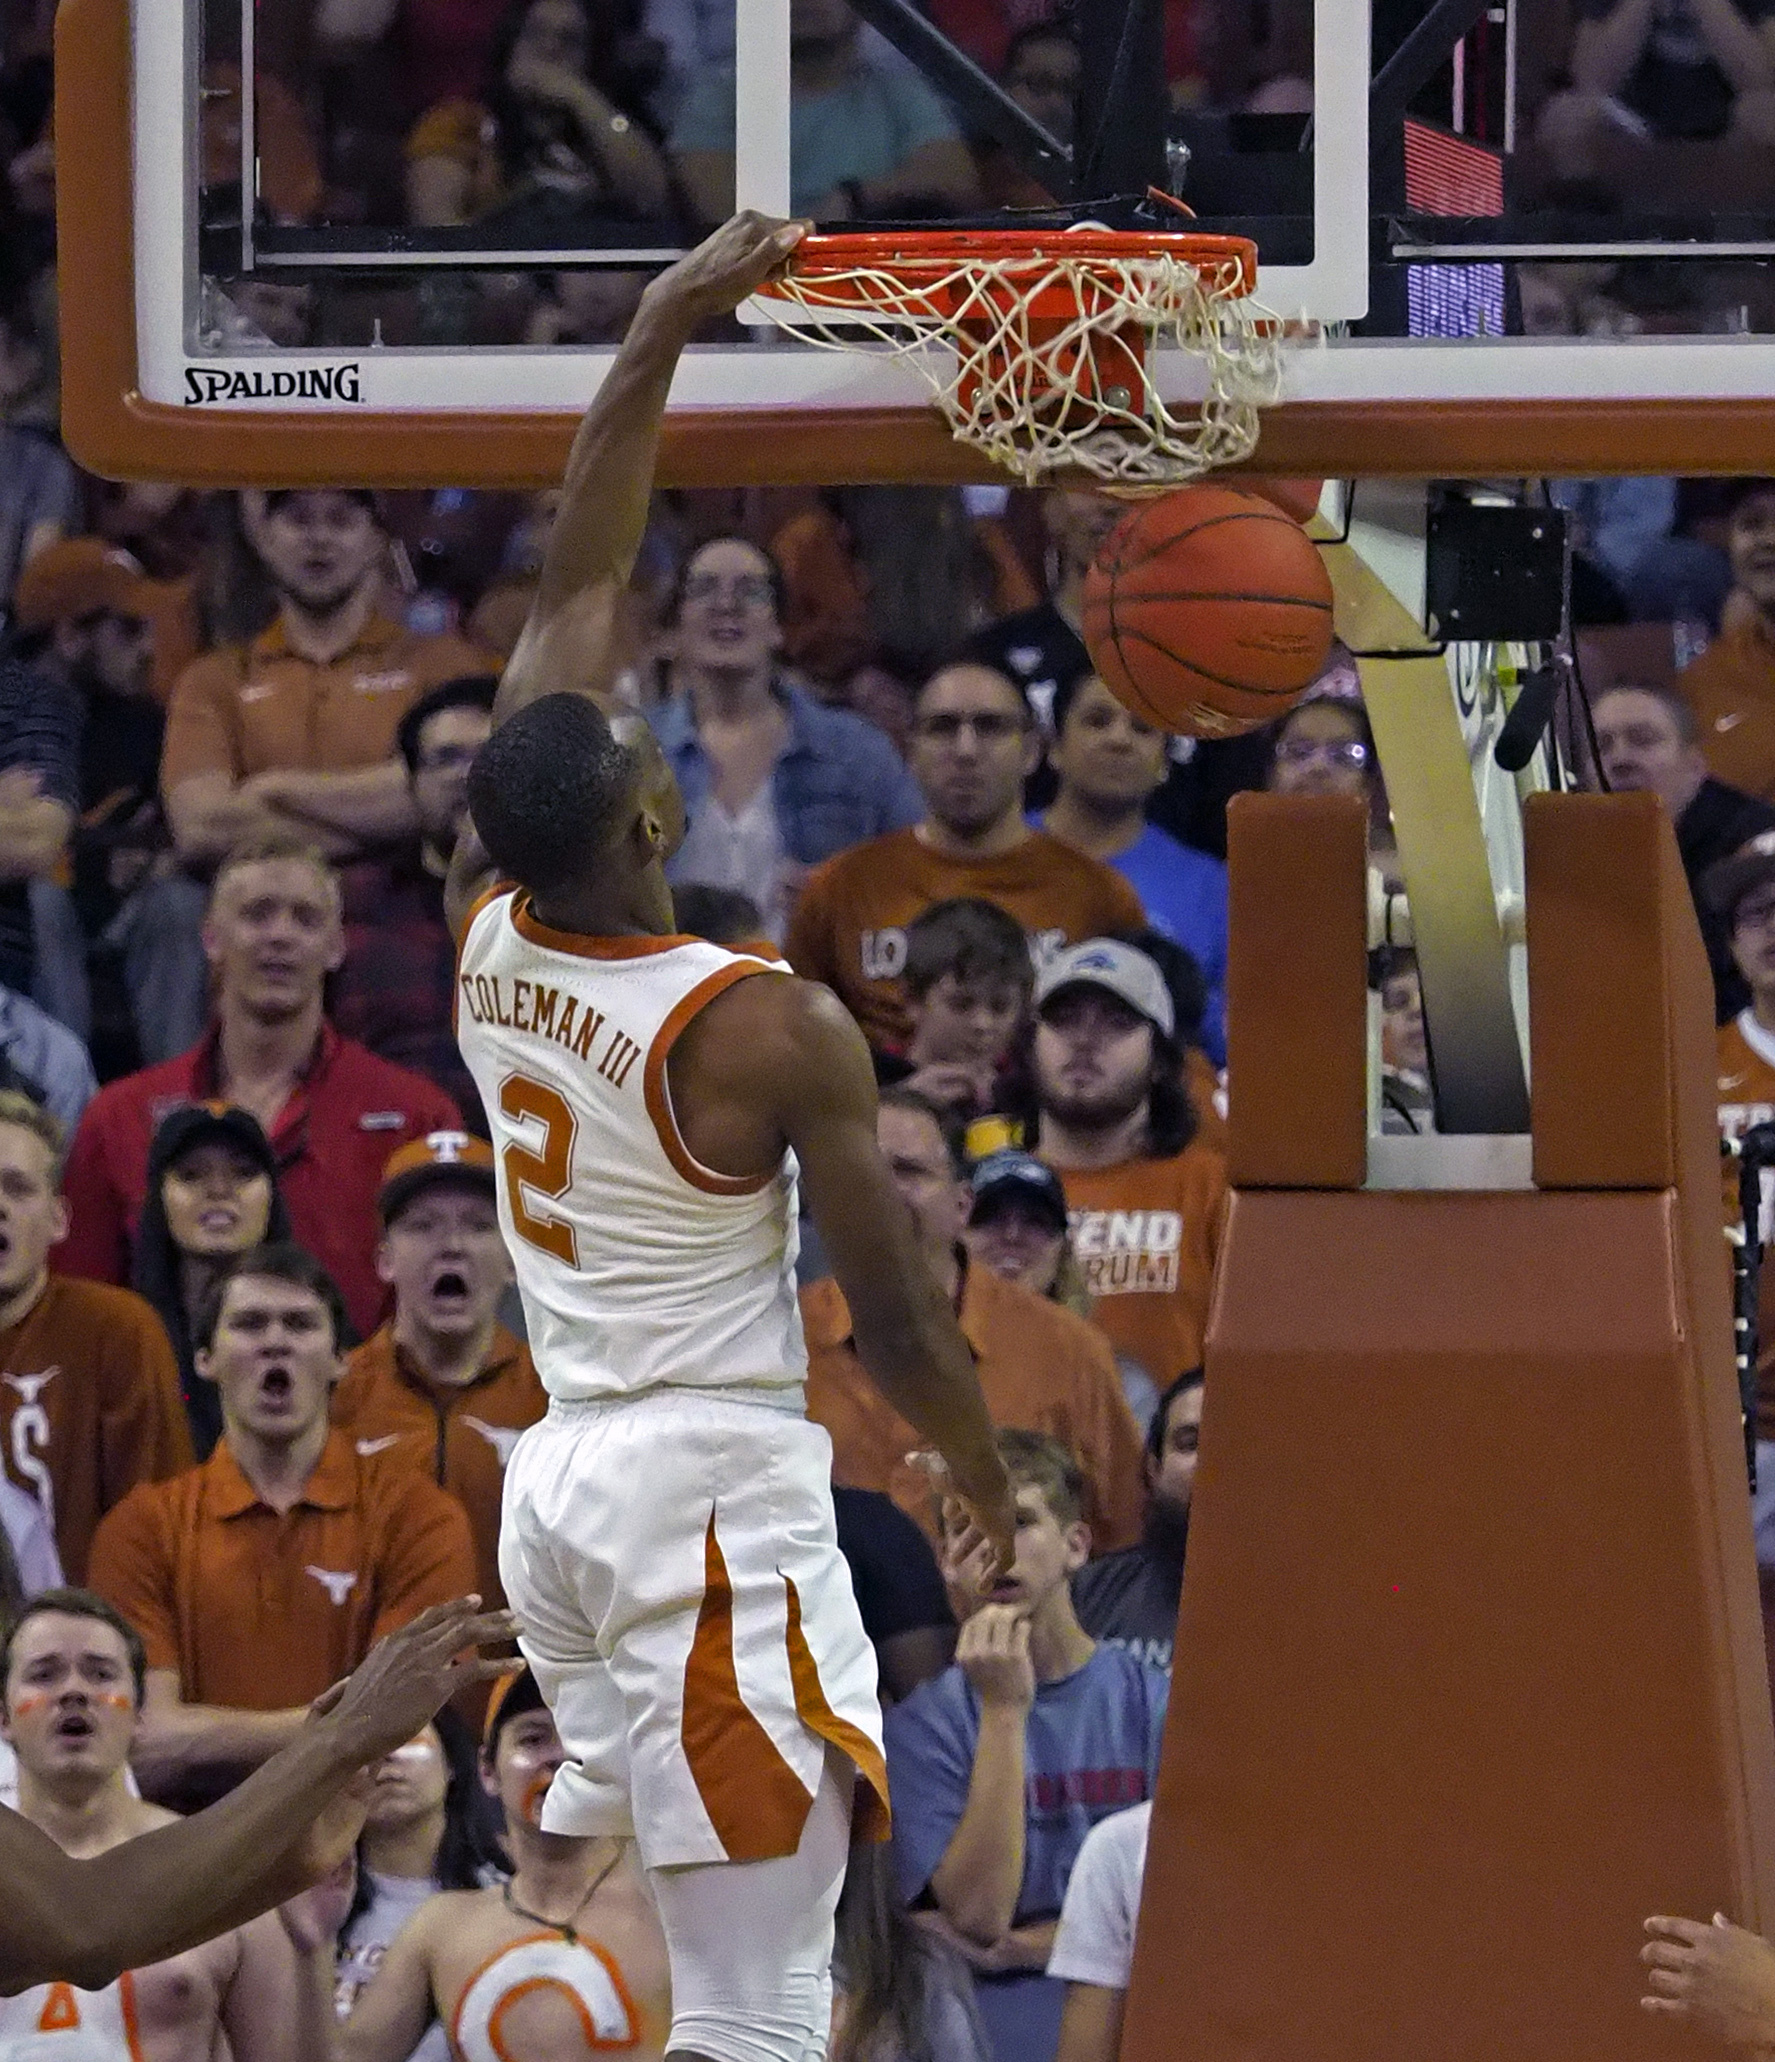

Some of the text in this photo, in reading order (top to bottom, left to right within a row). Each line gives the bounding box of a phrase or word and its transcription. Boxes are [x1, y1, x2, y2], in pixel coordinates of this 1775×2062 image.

[184, 363, 359, 406] SPALDING
[461, 973, 642, 1089] COLEMAN III
[425, 1130, 469, 1163] T
[498, 1070, 581, 1271] 2
